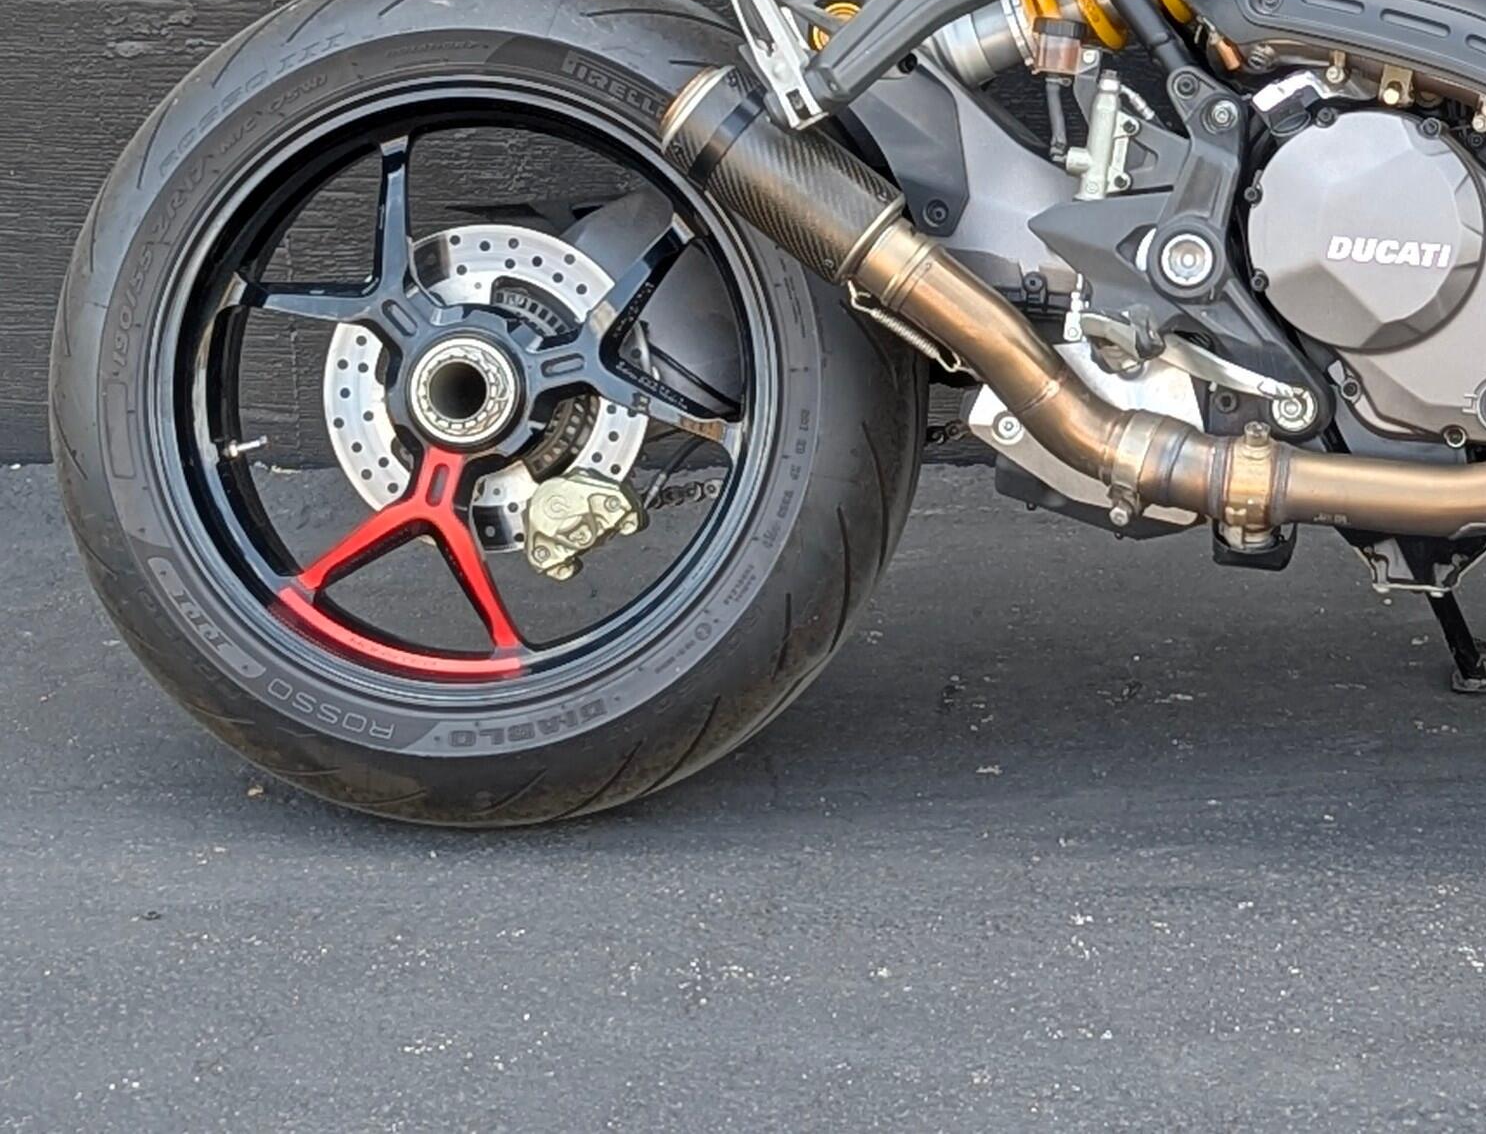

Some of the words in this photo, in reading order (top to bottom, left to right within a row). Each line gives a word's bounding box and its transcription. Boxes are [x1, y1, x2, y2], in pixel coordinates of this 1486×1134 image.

[1326, 235, 1452, 268] DUCATI
[266, 677, 396, 741] ROSSO
[447, 698, 608, 748] DIABLO
